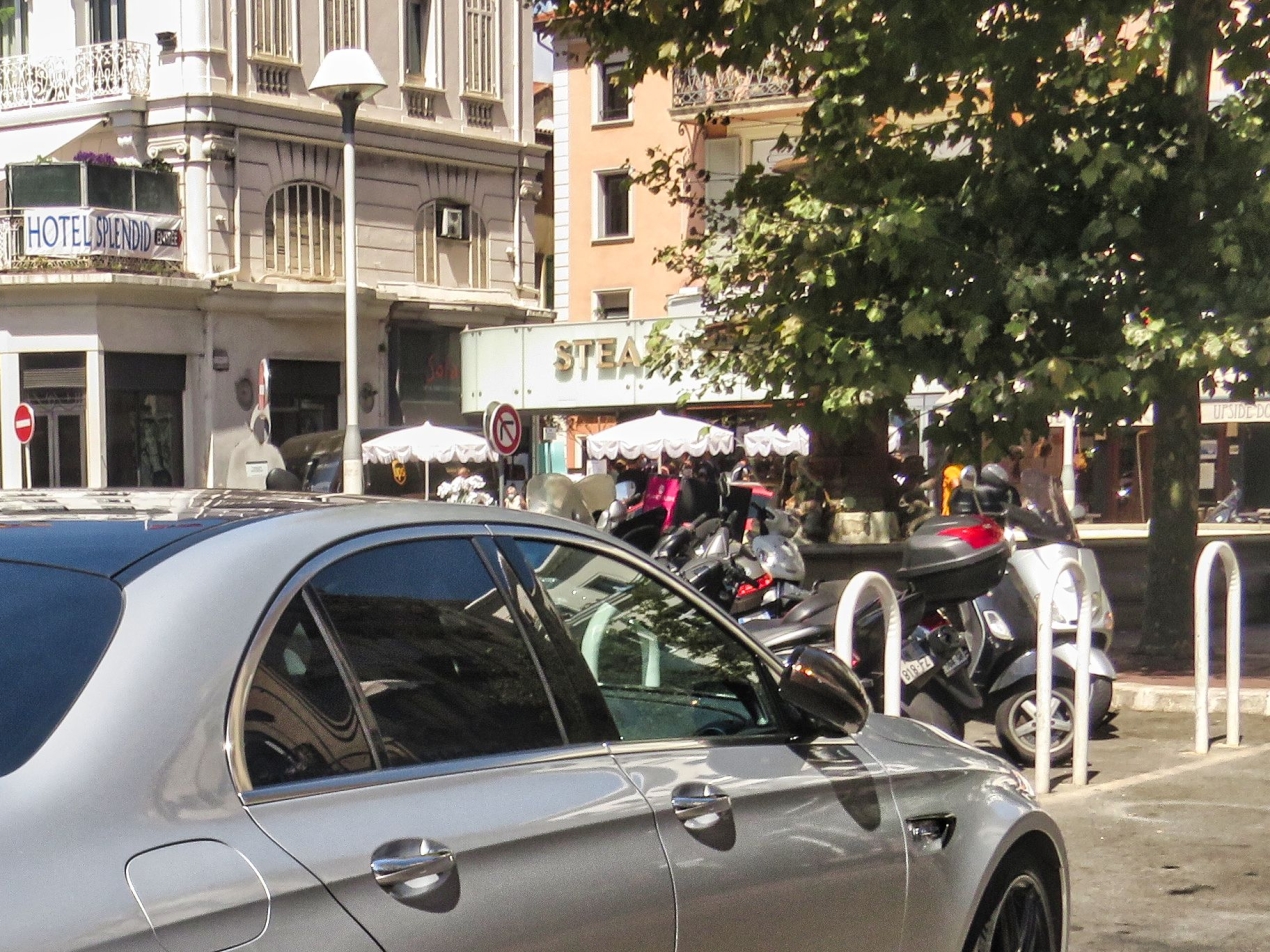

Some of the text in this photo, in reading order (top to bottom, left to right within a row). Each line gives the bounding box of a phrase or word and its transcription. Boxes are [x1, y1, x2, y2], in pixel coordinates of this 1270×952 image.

[28, 215, 152, 252] HOTEL SPLENDID
[554, 336, 643, 371] STEA
[1214, 404, 1253, 419] UPSIDE
